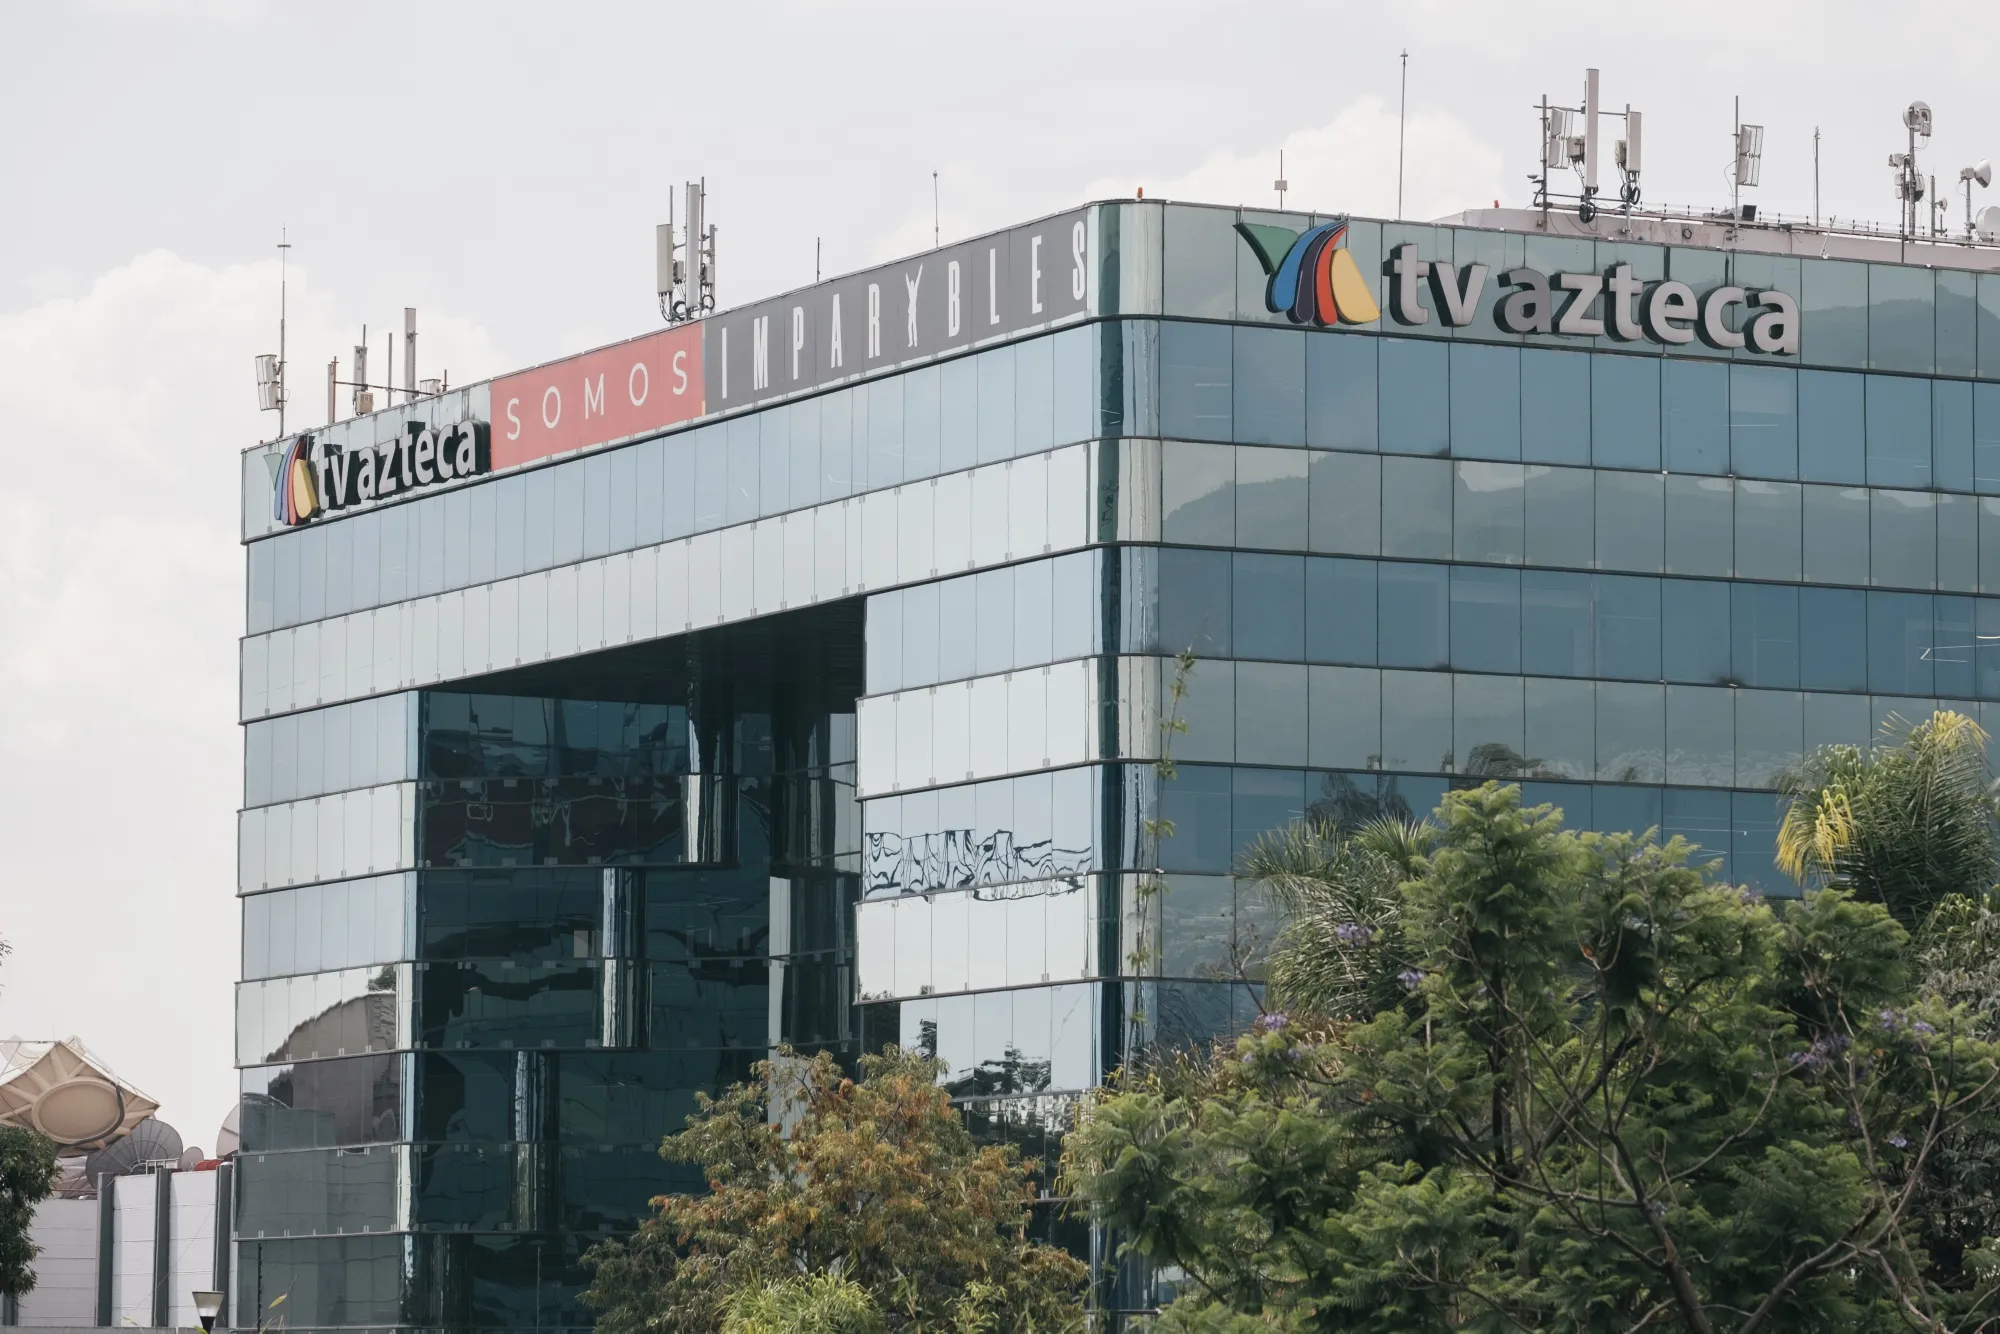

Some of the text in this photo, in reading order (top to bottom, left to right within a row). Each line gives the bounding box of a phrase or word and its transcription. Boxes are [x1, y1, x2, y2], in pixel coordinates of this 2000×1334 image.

[1383, 242, 1800, 356] tv azteca
[506, 350, 688, 440] SOMOS
[317, 419, 484, 511] tv azteca
